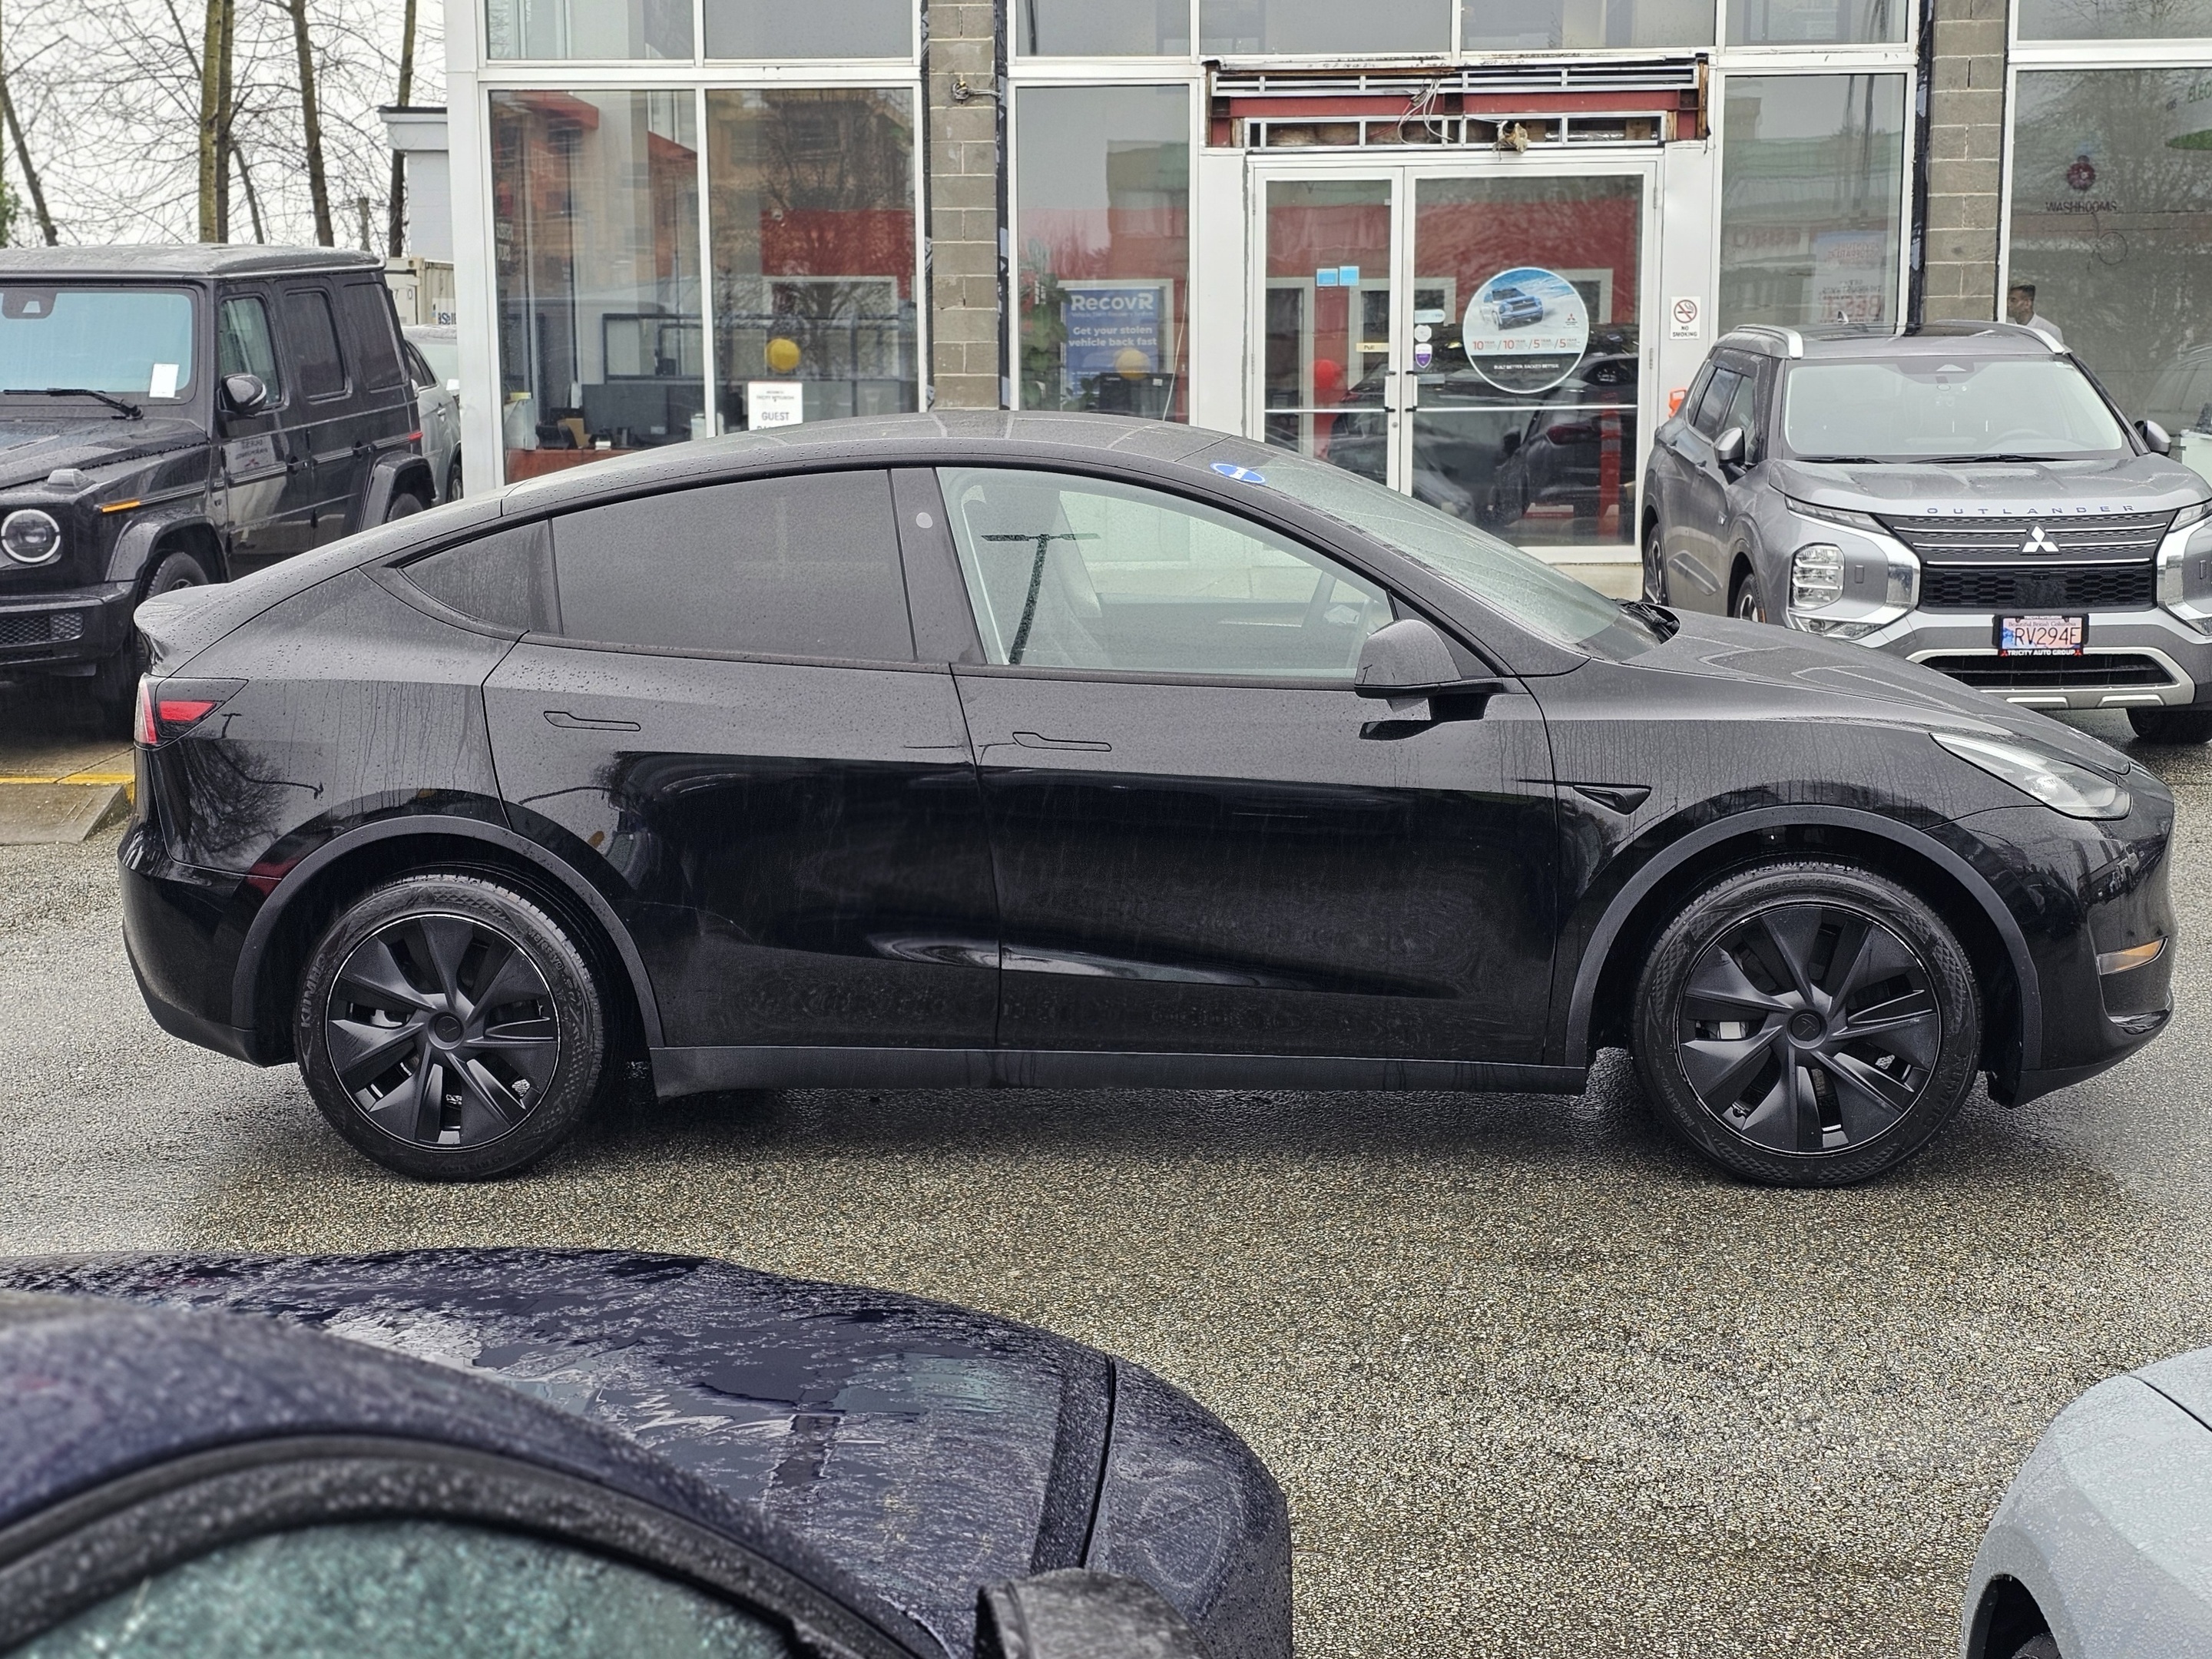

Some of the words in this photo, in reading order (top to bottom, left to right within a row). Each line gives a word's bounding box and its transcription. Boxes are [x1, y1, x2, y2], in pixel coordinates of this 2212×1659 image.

[2045, 200, 2117, 213] WASHROOMS
[1071, 293, 1154, 311] RecovR
[1094, 328, 1118, 336] your
[1120, 326, 1152, 334] stolen
[1068, 338, 1107, 346] vehicle
[1109, 338, 1134, 346] back
[1137, 337, 1157, 346] fast
[1472, 340, 1484, 350] 10
[1503, 339, 1515, 349] 10
[1534, 339, 1540, 349] 5
[1560, 338, 1566, 348] 5
[761, 412, 789, 421] GUEST
[1926, 505, 2134, 515] OUTLANDER
[2015, 627, 2081, 645] RV294E
[300, 952, 325, 1028] KUMHO
